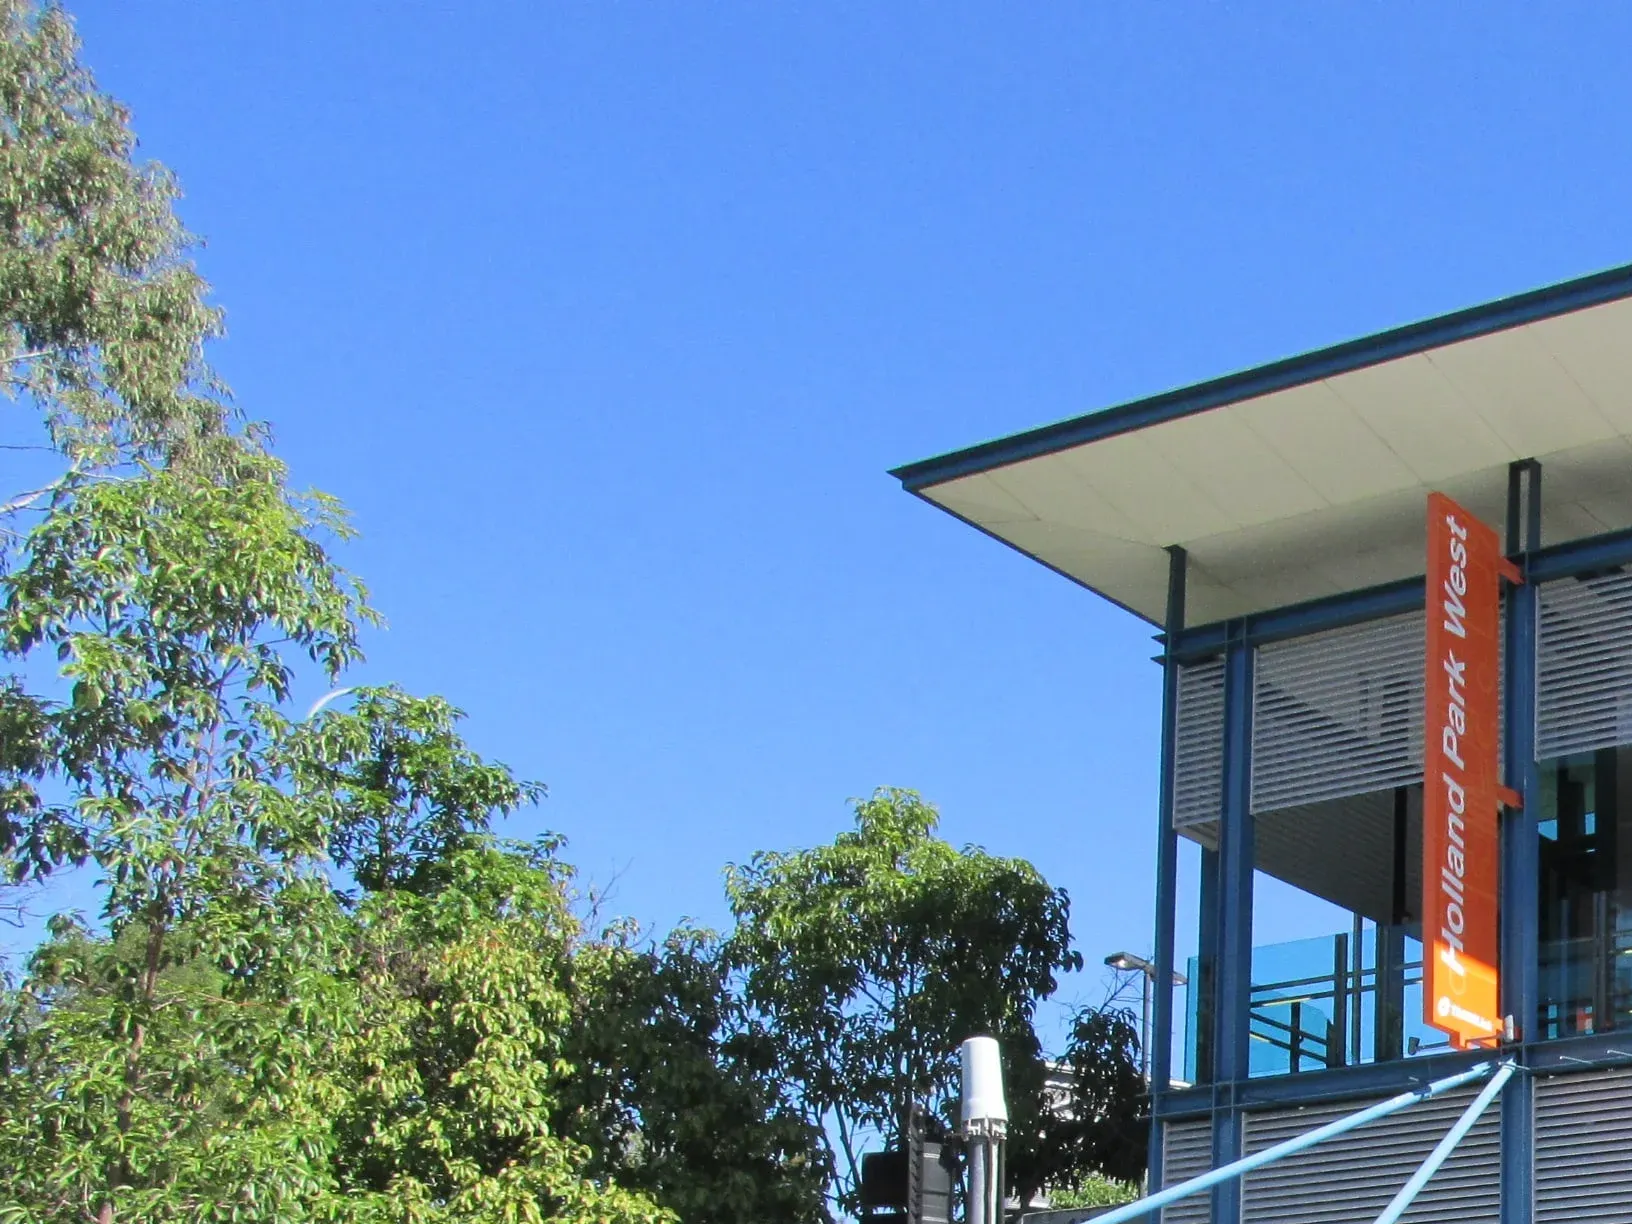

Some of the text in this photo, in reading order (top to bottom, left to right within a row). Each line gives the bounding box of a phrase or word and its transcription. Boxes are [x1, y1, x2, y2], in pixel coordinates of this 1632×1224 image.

[1441, 514, 1467, 977] Holland Park West
